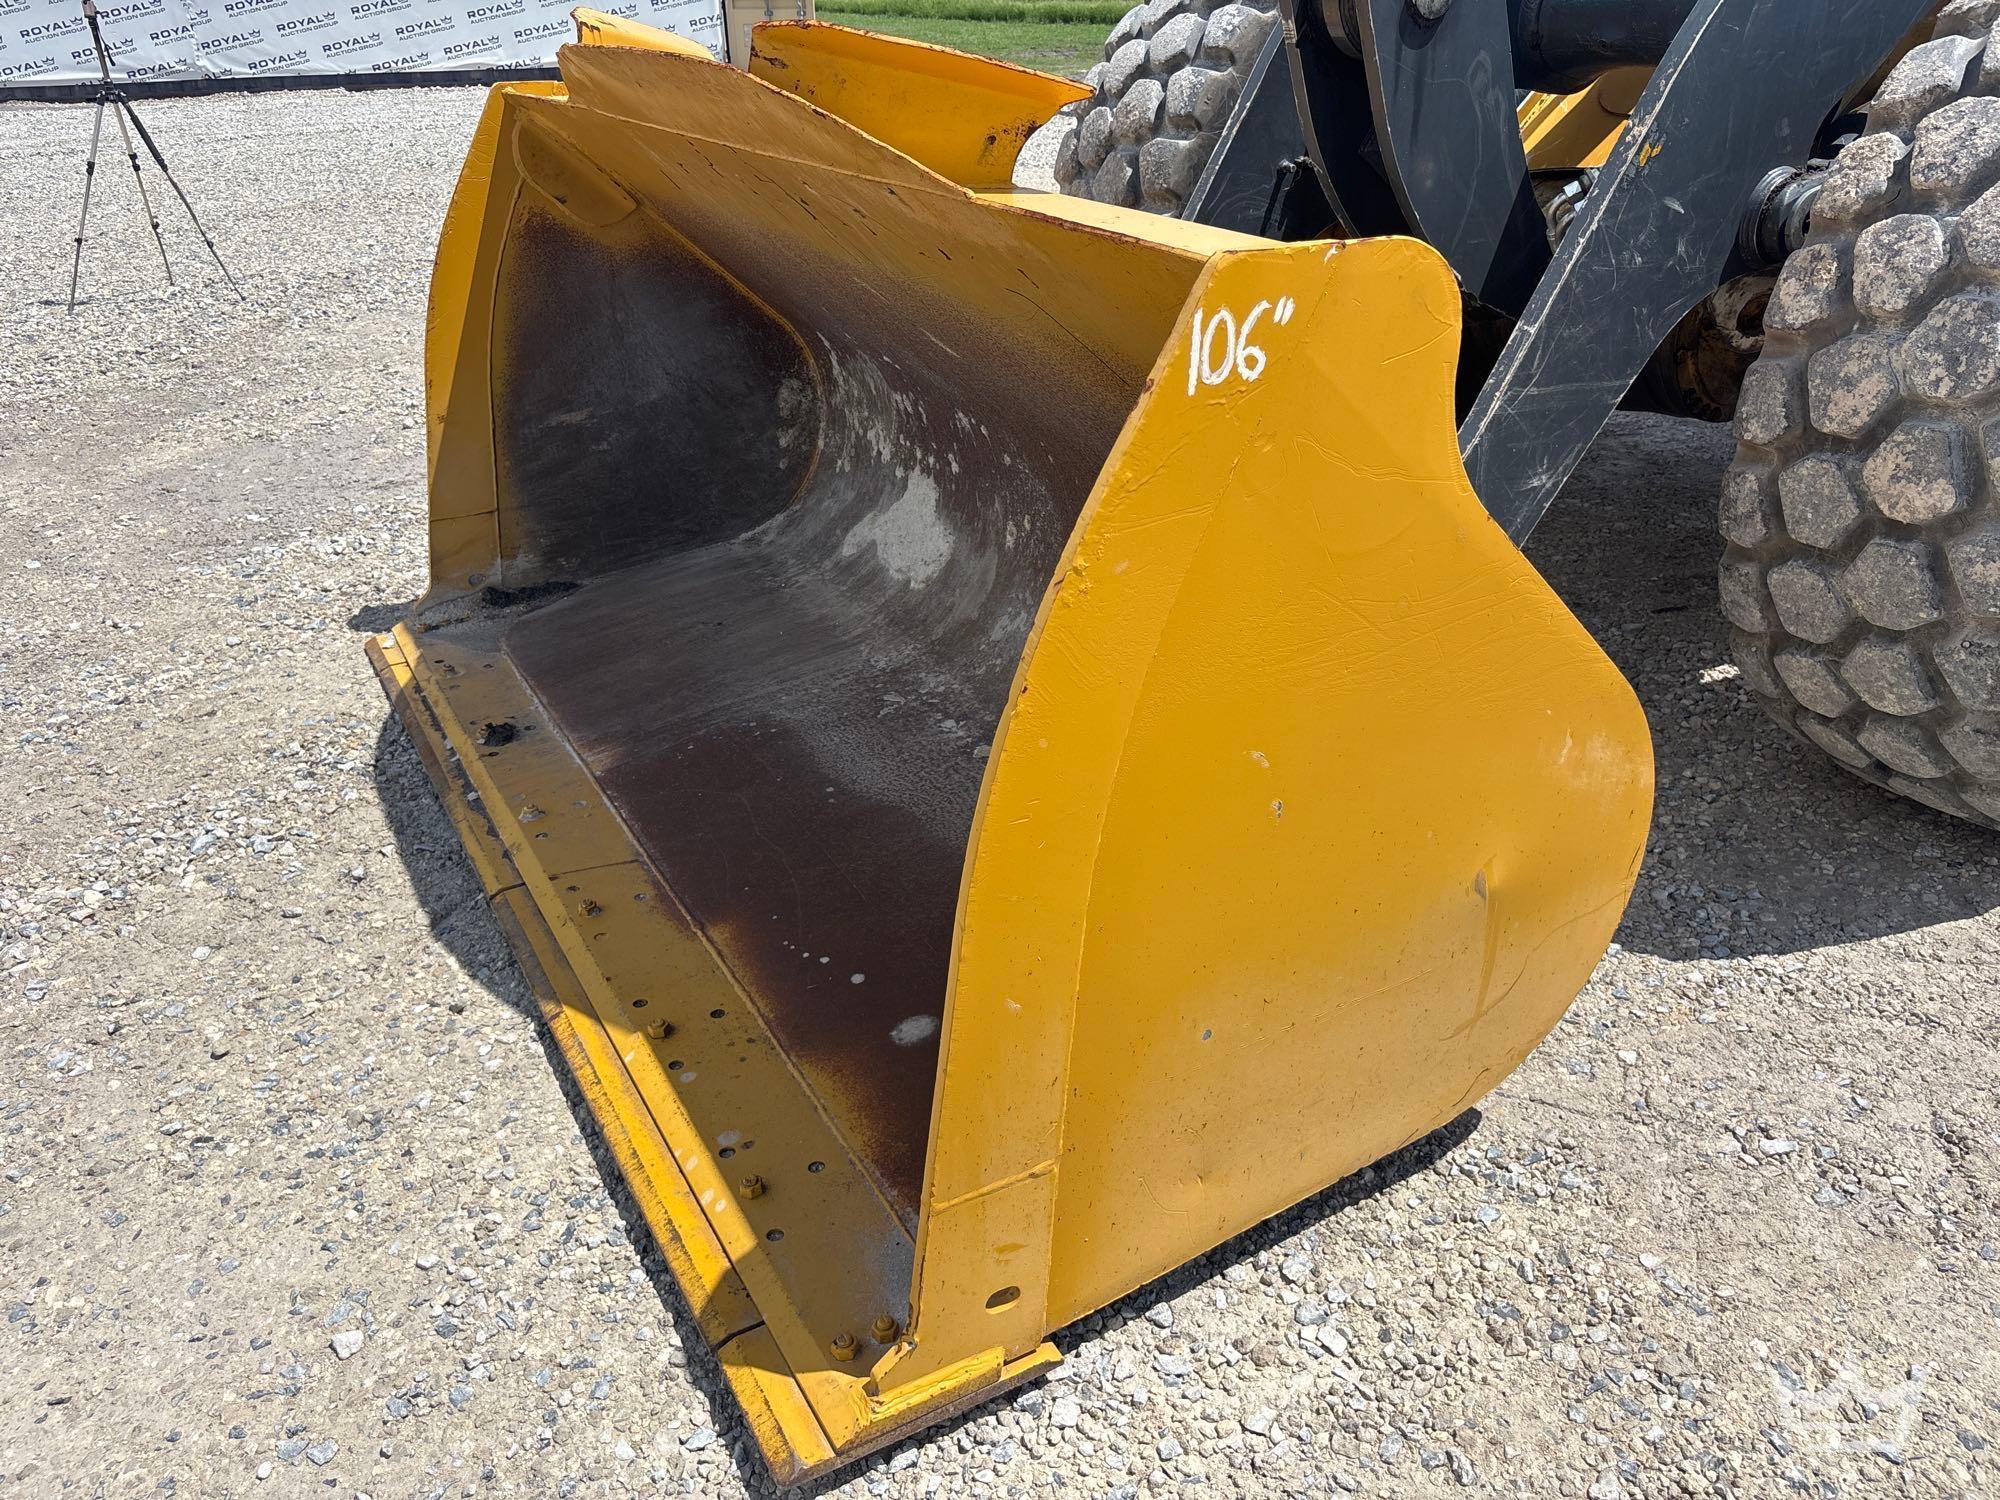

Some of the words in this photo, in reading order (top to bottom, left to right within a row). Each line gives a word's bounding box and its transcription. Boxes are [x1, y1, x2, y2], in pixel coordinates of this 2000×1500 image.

[3, 5, 30, 15] GROUP
[99, 2, 150, 19] ROYAL
[229, 7, 261, 18] AUCTION
[262, 1, 288, 11] GROUP
[350, 0, 397, 14] ROYAL
[354, 9, 386, 20] AUCTION
[387, 3, 411, 13] GROUP
[467, 2, 512, 19] ROYAL
[104, 14, 138, 26] AUCTION
[139, 8, 165, 18] GROUP
[276, 15, 324, 32] ROYAL
[471, 13, 500, 24] AUCTION
[501, 8, 525, 17] GROUP
[689, 14, 722, 27] ROYA
[20, 20, 71, 38] ROYAL
[25, 32, 59, 44] AUCTION
[60, 25, 87, 36] GROUP
[280, 26, 312, 38] AUCTION
[313, 20, 339, 30] GROUP
[395, 19, 441, 35] ROYAL
[399, 30, 430, 41] AUCTION
[431, 24, 455, 34] GROUP
[514, 22, 558, 38] ROYAL
[517, 33, 547, 44] AUCTION
[548, 27, 571, 37] GROUP
[154, 35, 187, 47] AUCTION
[200, 33, 249, 50] ROYAL
[205, 45, 237, 56] AUCTION
[238, 38, 264, 48] GROUP
[322, 36, 369, 52] ROYAL
[326, 47, 357, 58] AUCTION
[358, 41, 383, 51] GROUP
[443, 38, 489, 55] ROYAL
[447, 50, 477, 61] AUCTION
[478, 44, 502, 53] GROUP
[0, 61, 43, 77] OYAL
[31, 65, 59, 76] GROUP
[126, 62, 176, 79] ROYAL
[248, 53, 296, 71] ROYAL
[252, 65, 284, 76] AUCTION
[285, 58, 310, 69] GROUP
[371, 55, 418, 72] ROYAL
[407, 60, 432, 70] GROUP
[165, 67, 191, 77] GROUP
[1187, 295, 1296, 397] 106"
